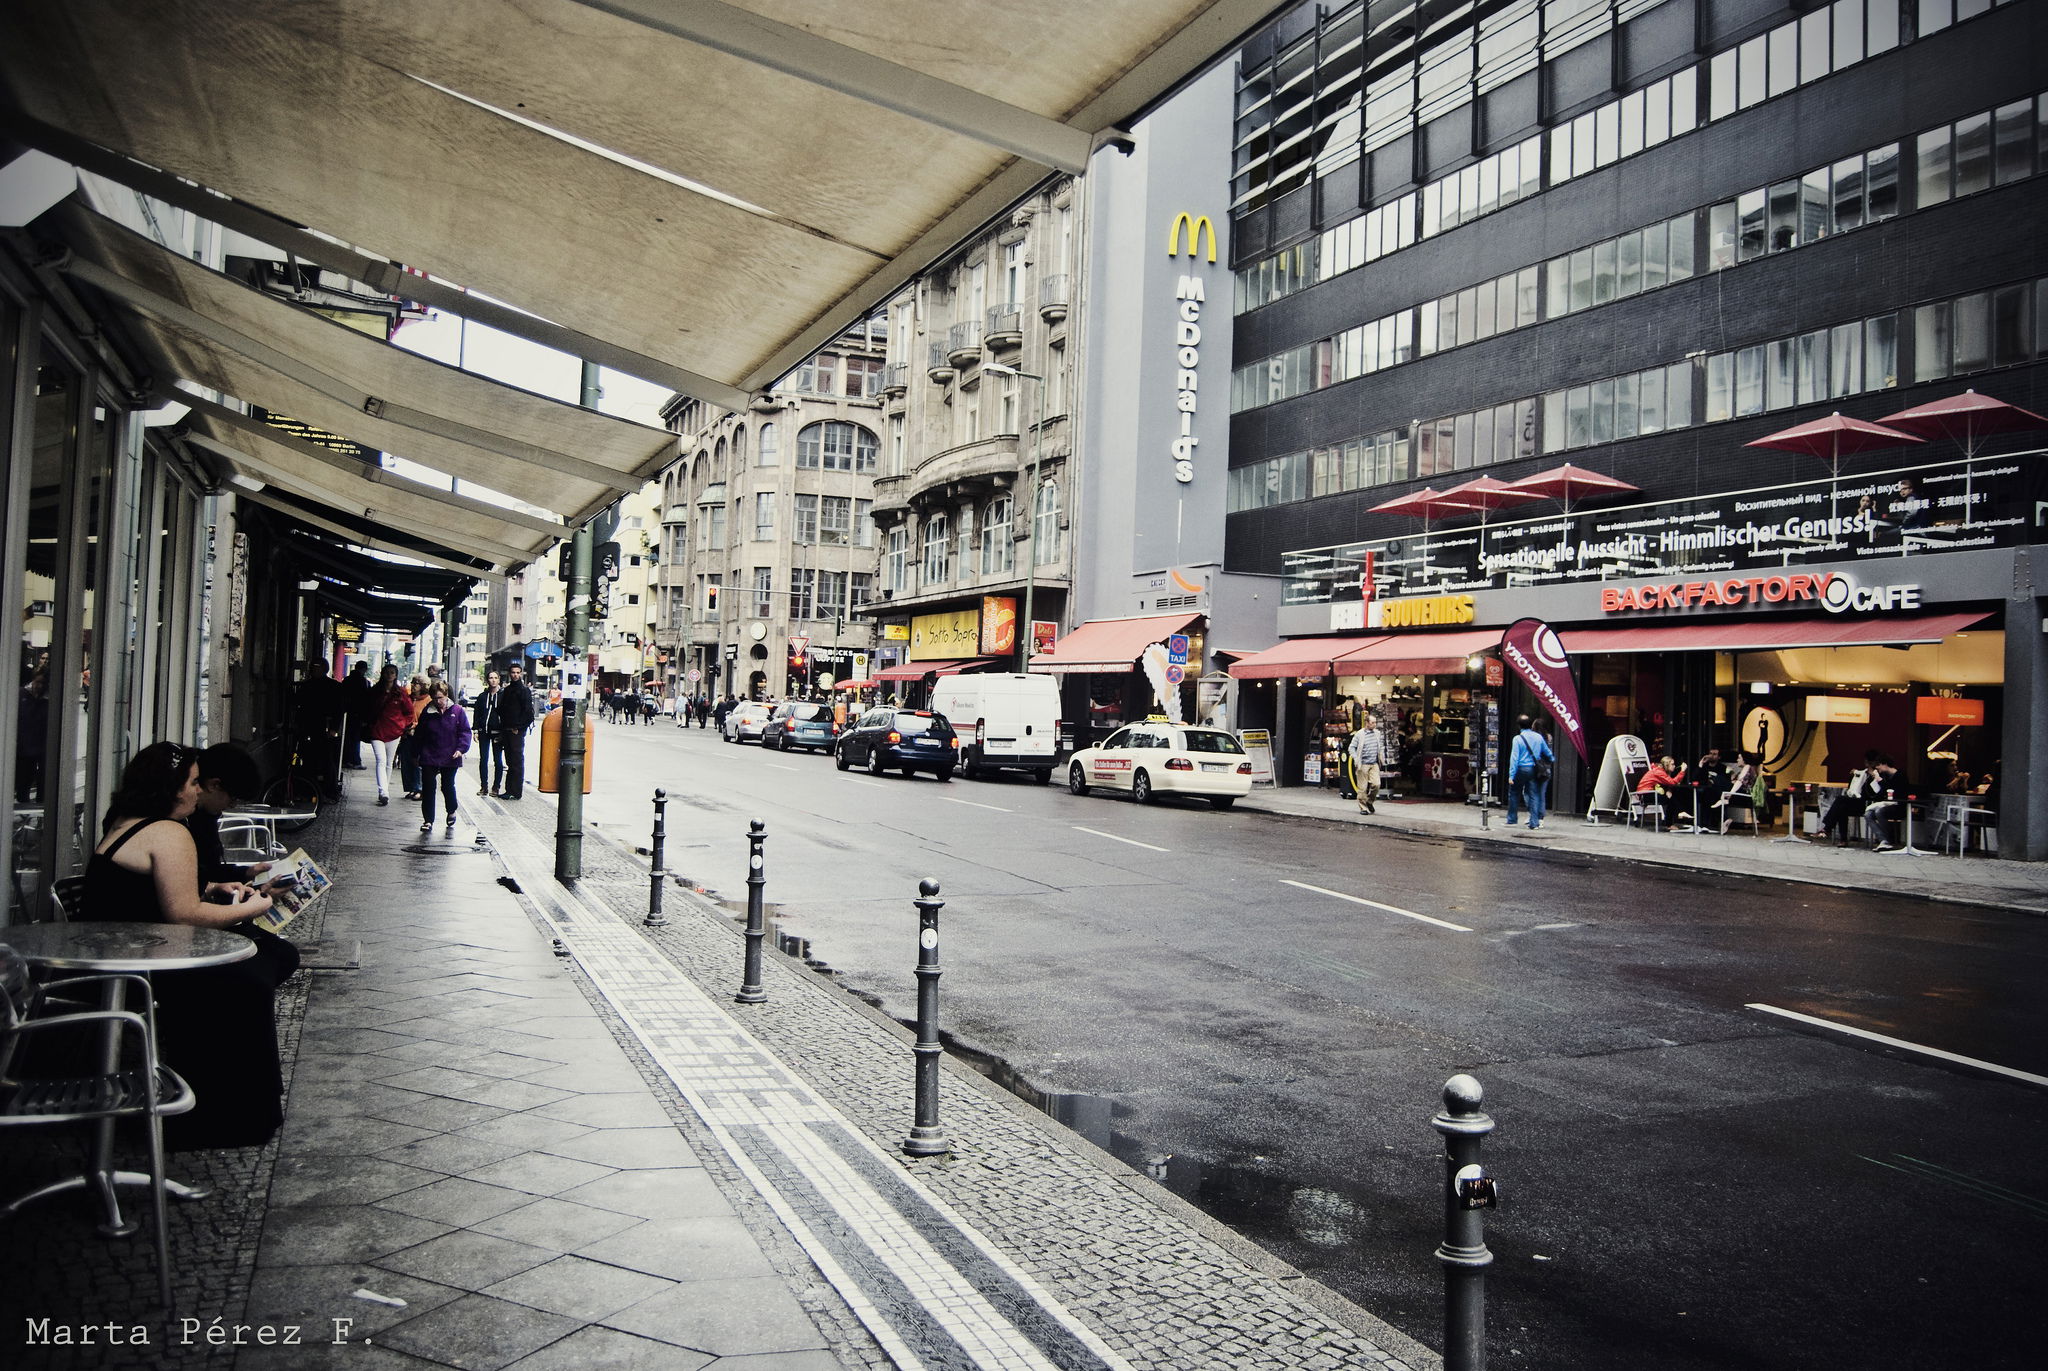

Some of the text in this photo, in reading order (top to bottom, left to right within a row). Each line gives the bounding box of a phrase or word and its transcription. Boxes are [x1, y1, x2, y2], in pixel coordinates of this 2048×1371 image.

[1171, 275, 1205, 483] McDonald's
[1478, 541, 1575, 570] Sensationelle
[1577, 534, 1647, 560] Aussicht
[1660, 521, 1780, 553] Himmlischer
[1784, 508, 1871, 539] Genuss!
[1382, 594, 1474, 628] SOUVENIRS
[1852, 584, 1921, 612] CAFE
[929, 623, 949, 645] Sotto
[1170, 654, 1186, 663] TAXI
